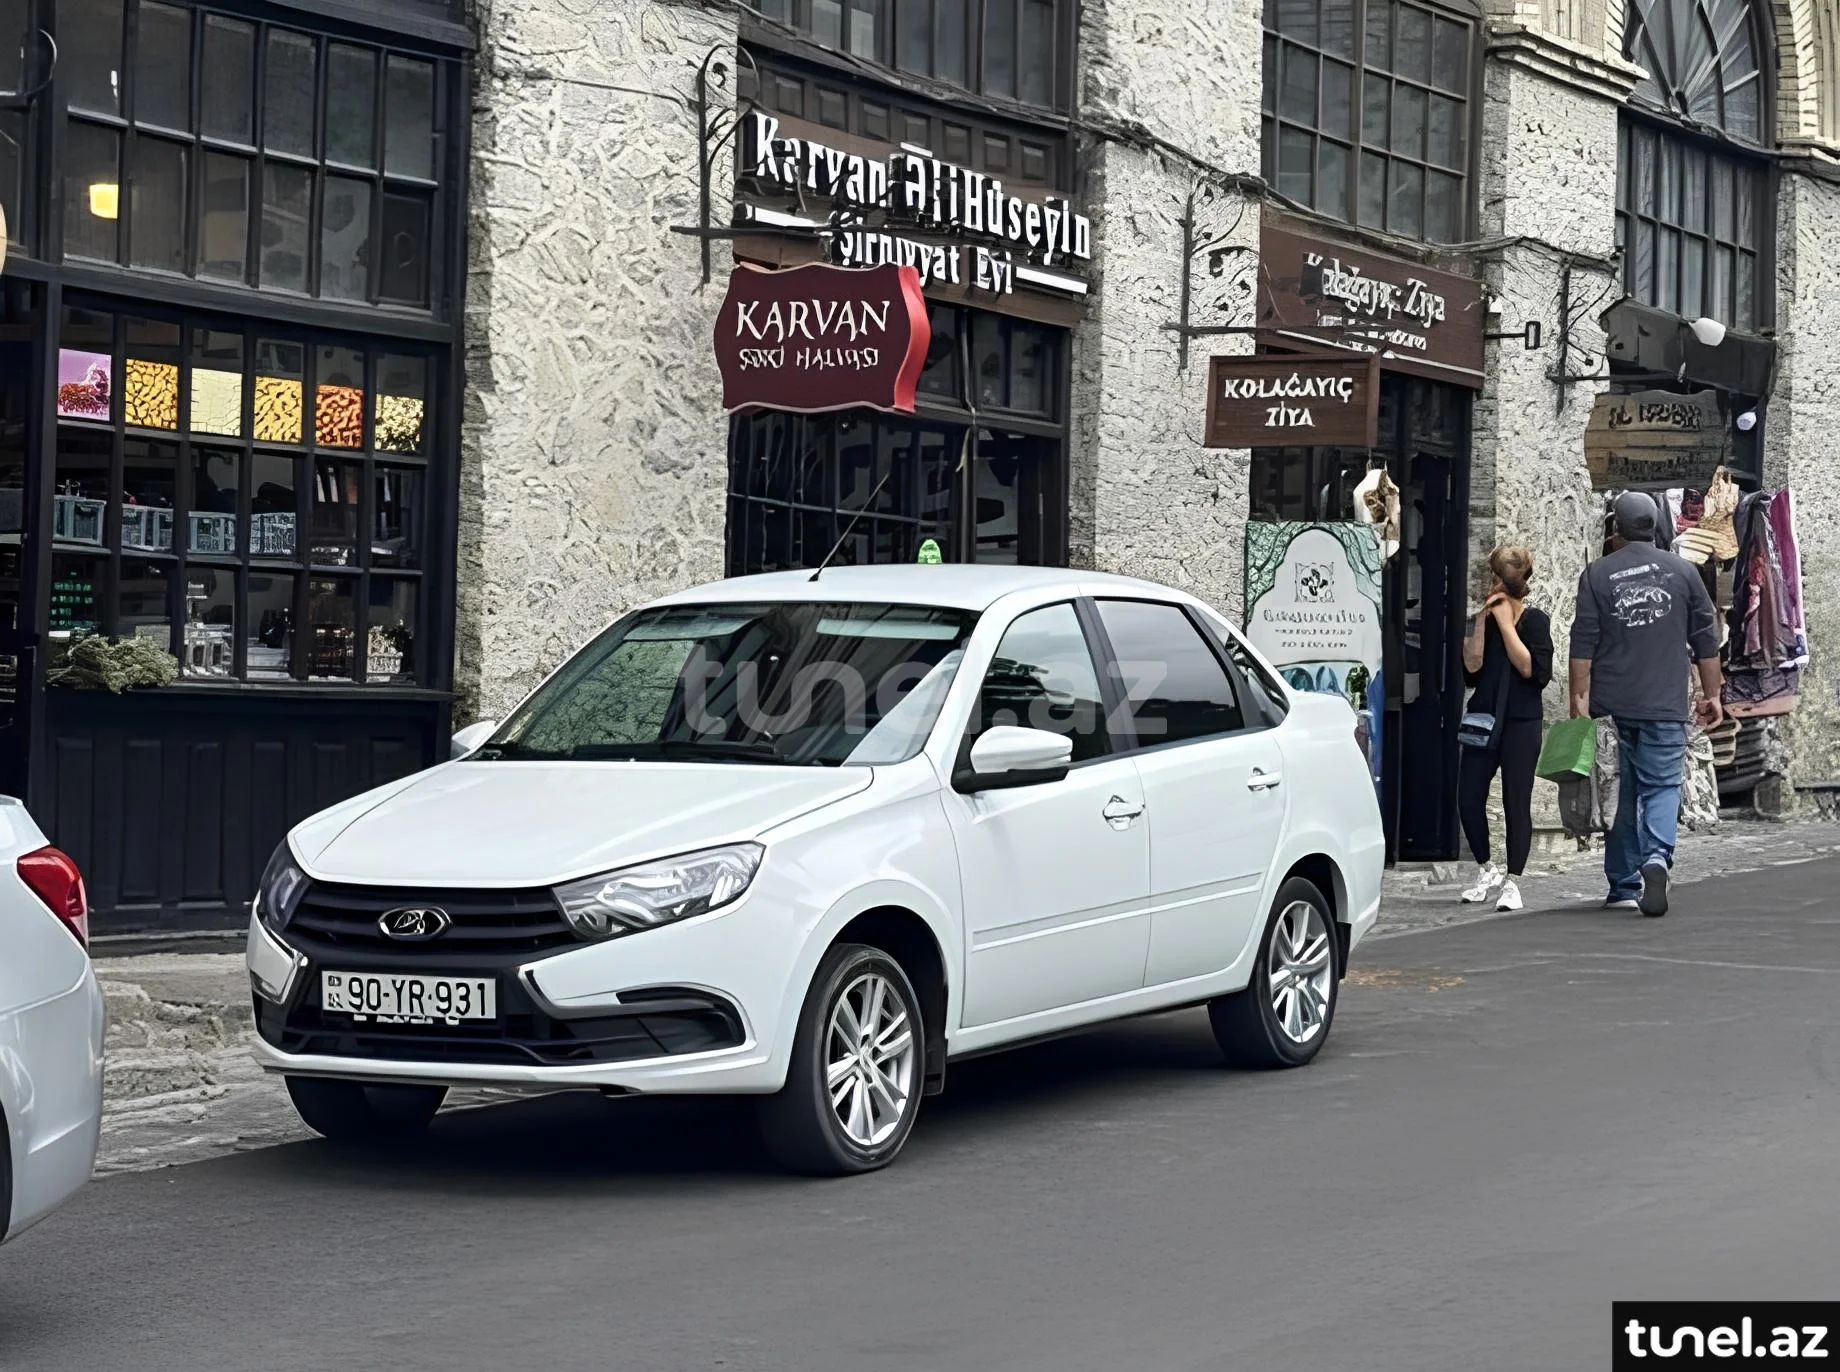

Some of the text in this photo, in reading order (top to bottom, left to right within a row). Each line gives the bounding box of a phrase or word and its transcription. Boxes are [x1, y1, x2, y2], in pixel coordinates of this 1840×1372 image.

[757, 112, 887, 207] Karvan
[736, 299, 890, 343] KARVAN
[348, 976, 486, 1017] 90-YR-931
